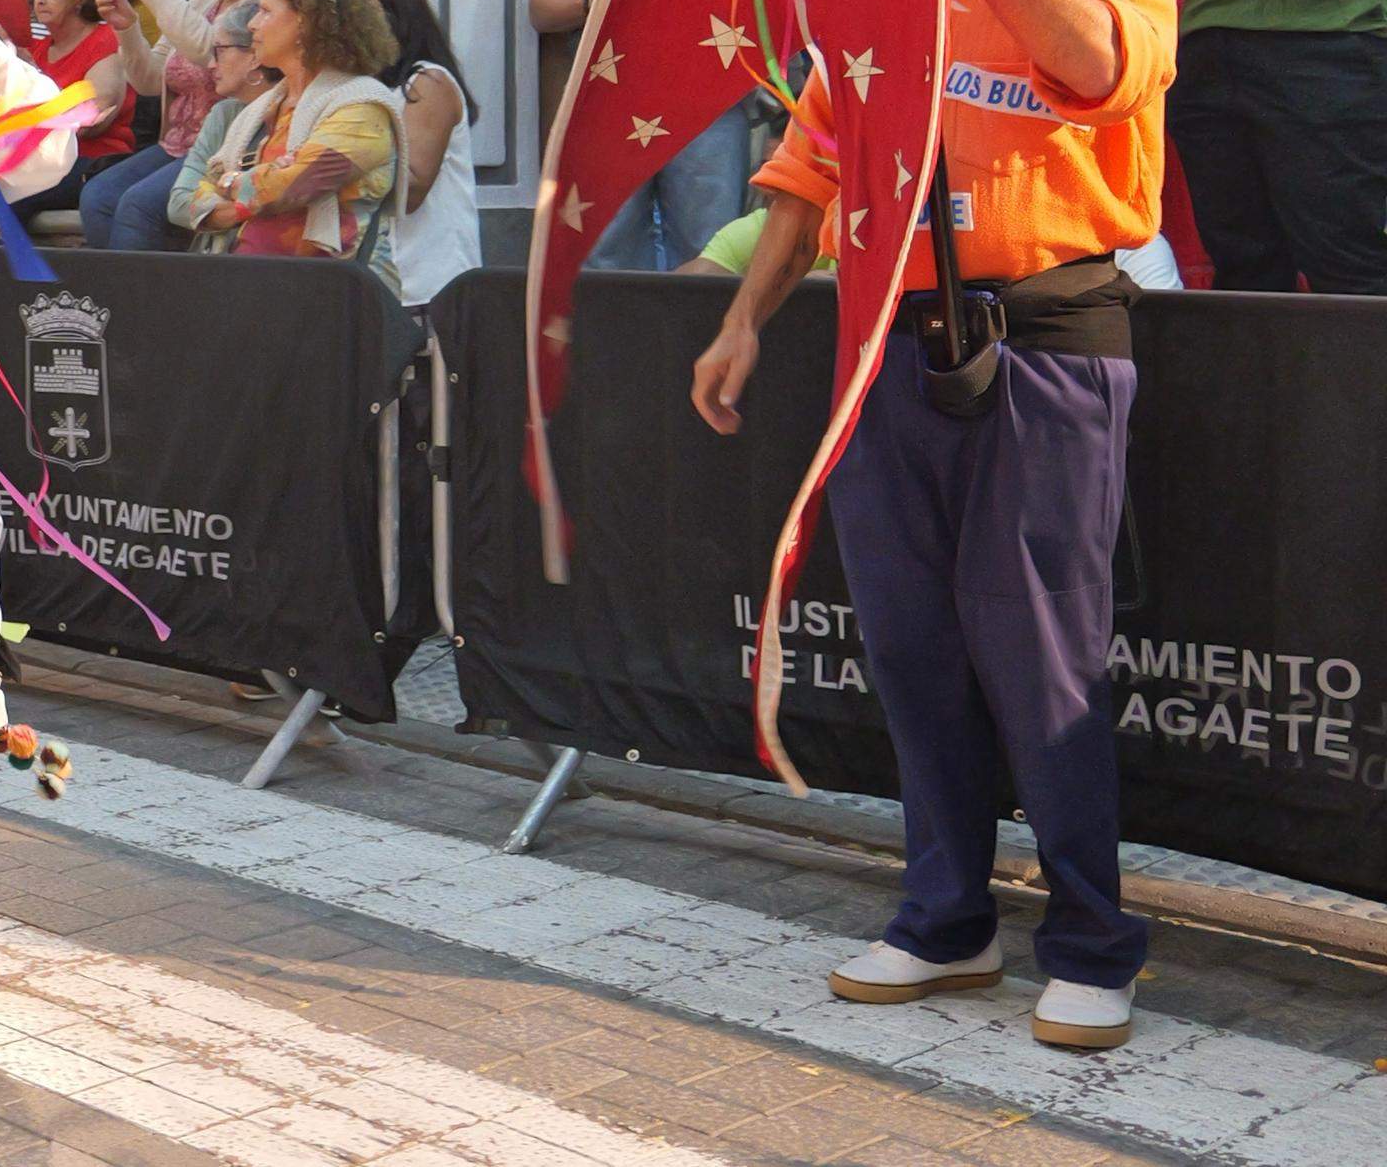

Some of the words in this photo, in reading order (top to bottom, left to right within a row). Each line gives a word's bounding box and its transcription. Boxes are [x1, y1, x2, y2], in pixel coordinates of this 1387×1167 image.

[945, 68, 981, 100] LOS
[813, 653, 869, 694] LA
[1117, 692, 1353, 761] AGAETE
